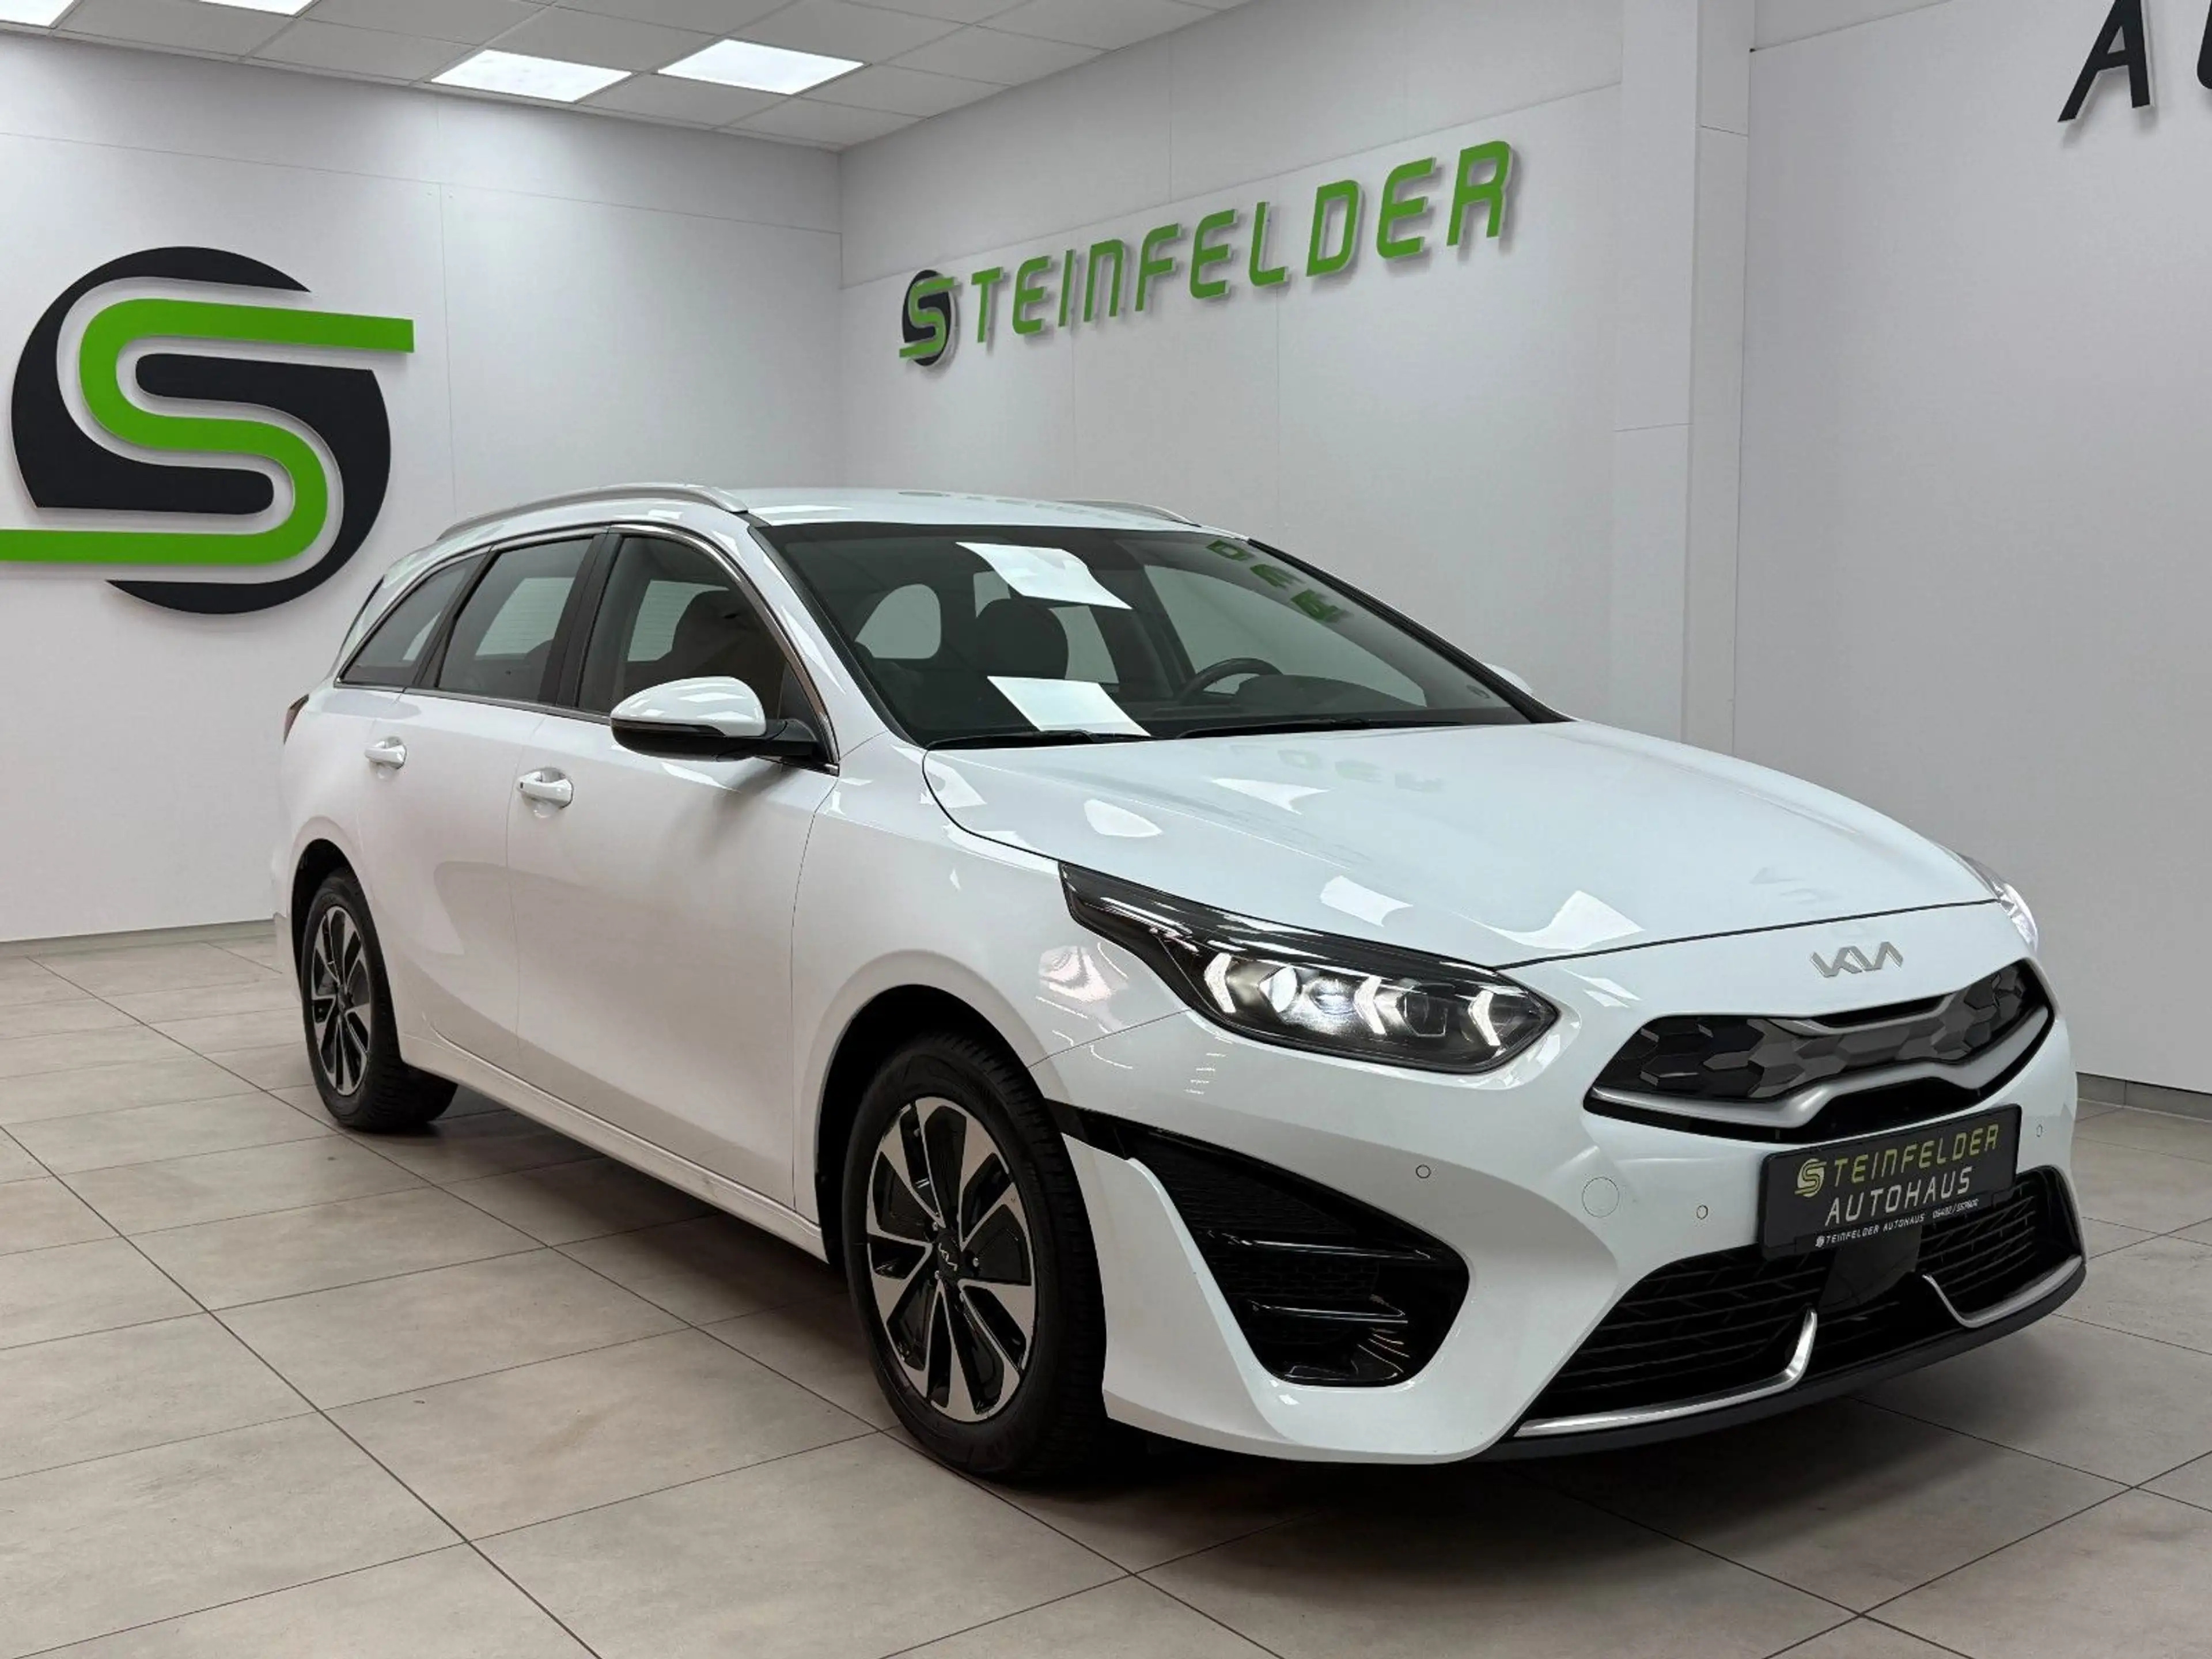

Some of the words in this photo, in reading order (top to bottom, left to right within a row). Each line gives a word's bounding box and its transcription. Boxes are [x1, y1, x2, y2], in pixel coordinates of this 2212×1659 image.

[2057, 0, 2212, 122] A
[899, 140, 1514, 366] STEINFELDER
[1809, 941, 1903, 978] KIA
[1794, 1124, 1999, 1198] STEINFELDER
[1825, 1166, 1973, 1226] AUTOHAUS
